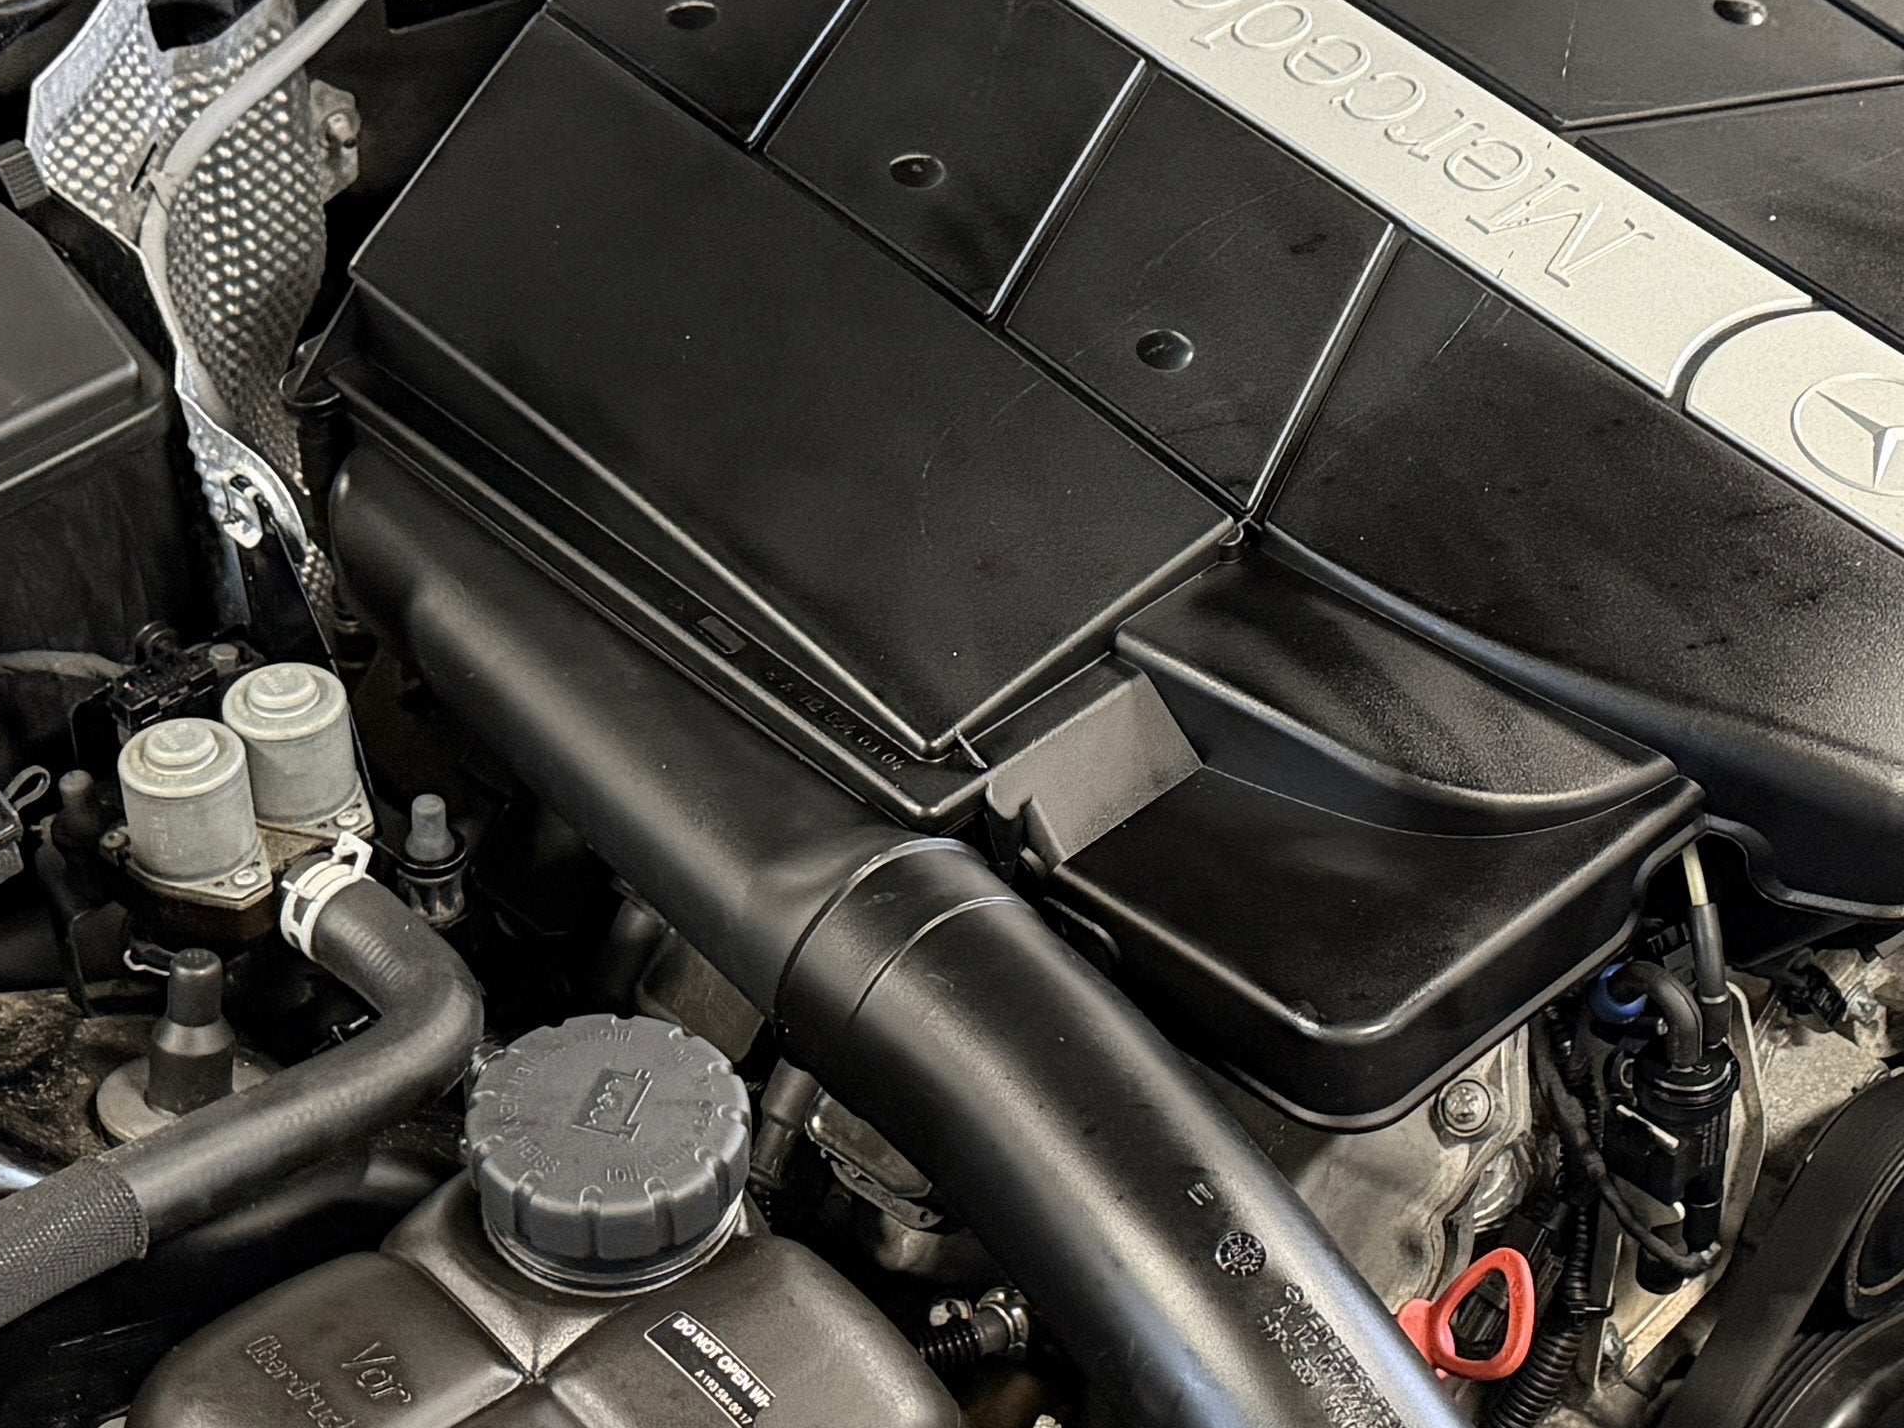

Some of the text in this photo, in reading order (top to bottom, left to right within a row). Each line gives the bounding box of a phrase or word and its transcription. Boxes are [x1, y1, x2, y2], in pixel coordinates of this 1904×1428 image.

[672, 1316, 697, 1338] DO
[690, 1331, 723, 1360] NOT
[715, 1353, 755, 1391] OPEN
[739, 1412, 753, 1425] 17
